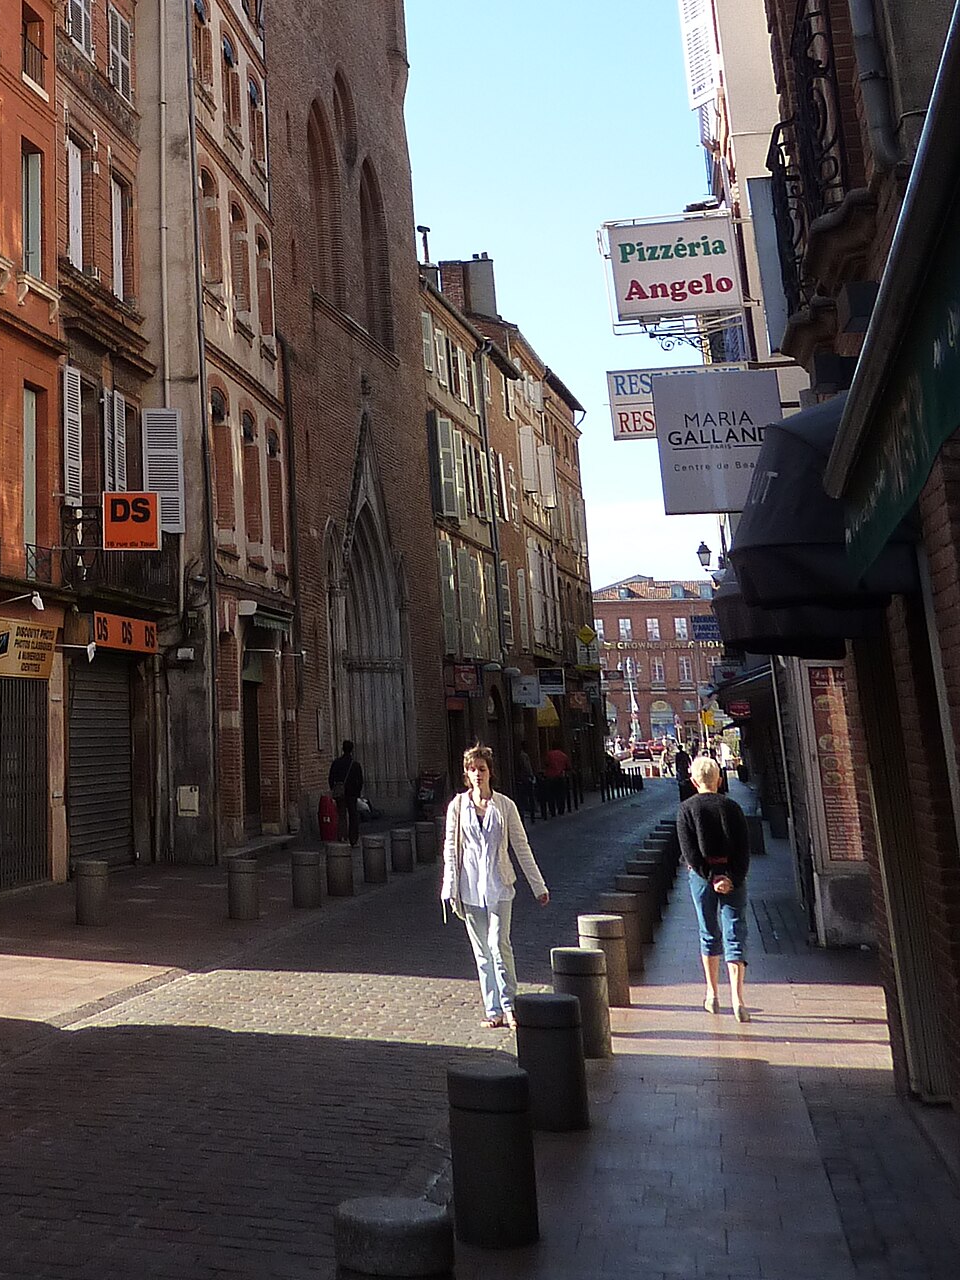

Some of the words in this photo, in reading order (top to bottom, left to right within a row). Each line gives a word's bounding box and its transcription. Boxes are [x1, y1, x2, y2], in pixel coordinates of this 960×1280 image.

[618, 235, 727, 263] Pizzéria
[625, 273, 733, 302] Angelo
[684, 410, 753, 428] MARIA
[674, 463, 711, 472] Centre
[716, 462, 729, 470] de
[735, 461, 759, 469] Bea
[110, 498, 151, 523] DS
[96, 616, 109, 642] DS
[121, 620, 133, 645] DS
[144, 625, 155, 649] DS
[617, 640, 659, 650] CROWNE
[663, 640, 694, 649] PLAZA
